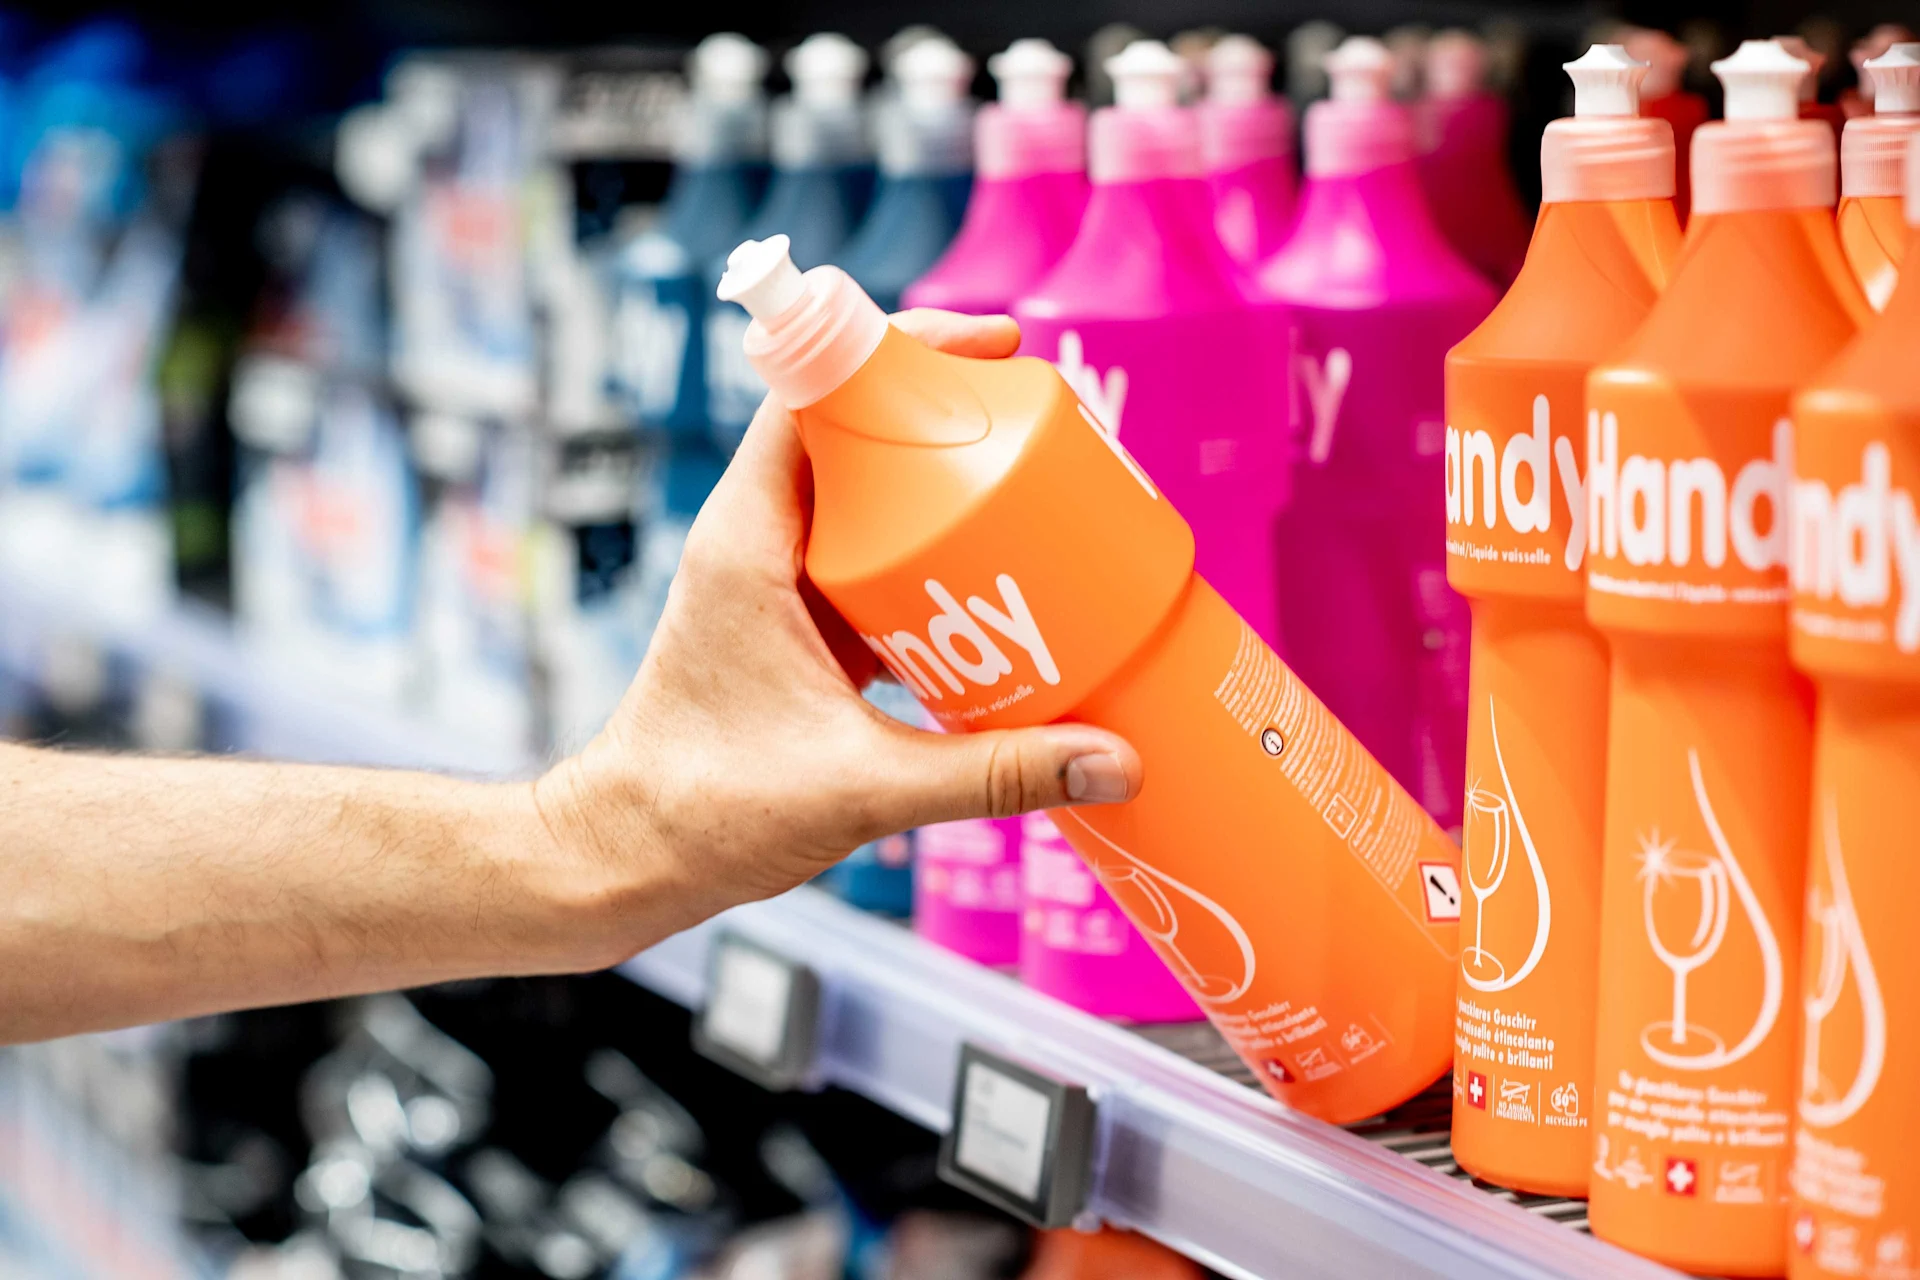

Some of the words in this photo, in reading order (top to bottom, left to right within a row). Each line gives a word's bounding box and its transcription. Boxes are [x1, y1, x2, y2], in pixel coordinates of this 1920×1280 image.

[1445, 393, 1588, 573] andy
[1587, 408, 1793, 572] Hand
[1502, 547, 1551, 565] vaisselle
[1793, 440, 1920, 654] ndy
[1493, 1008, 1537, 1031] Geschirr
[1494, 1027, 1555, 1052] étincelante
[1507, 1047, 1553, 1070] brillanti
